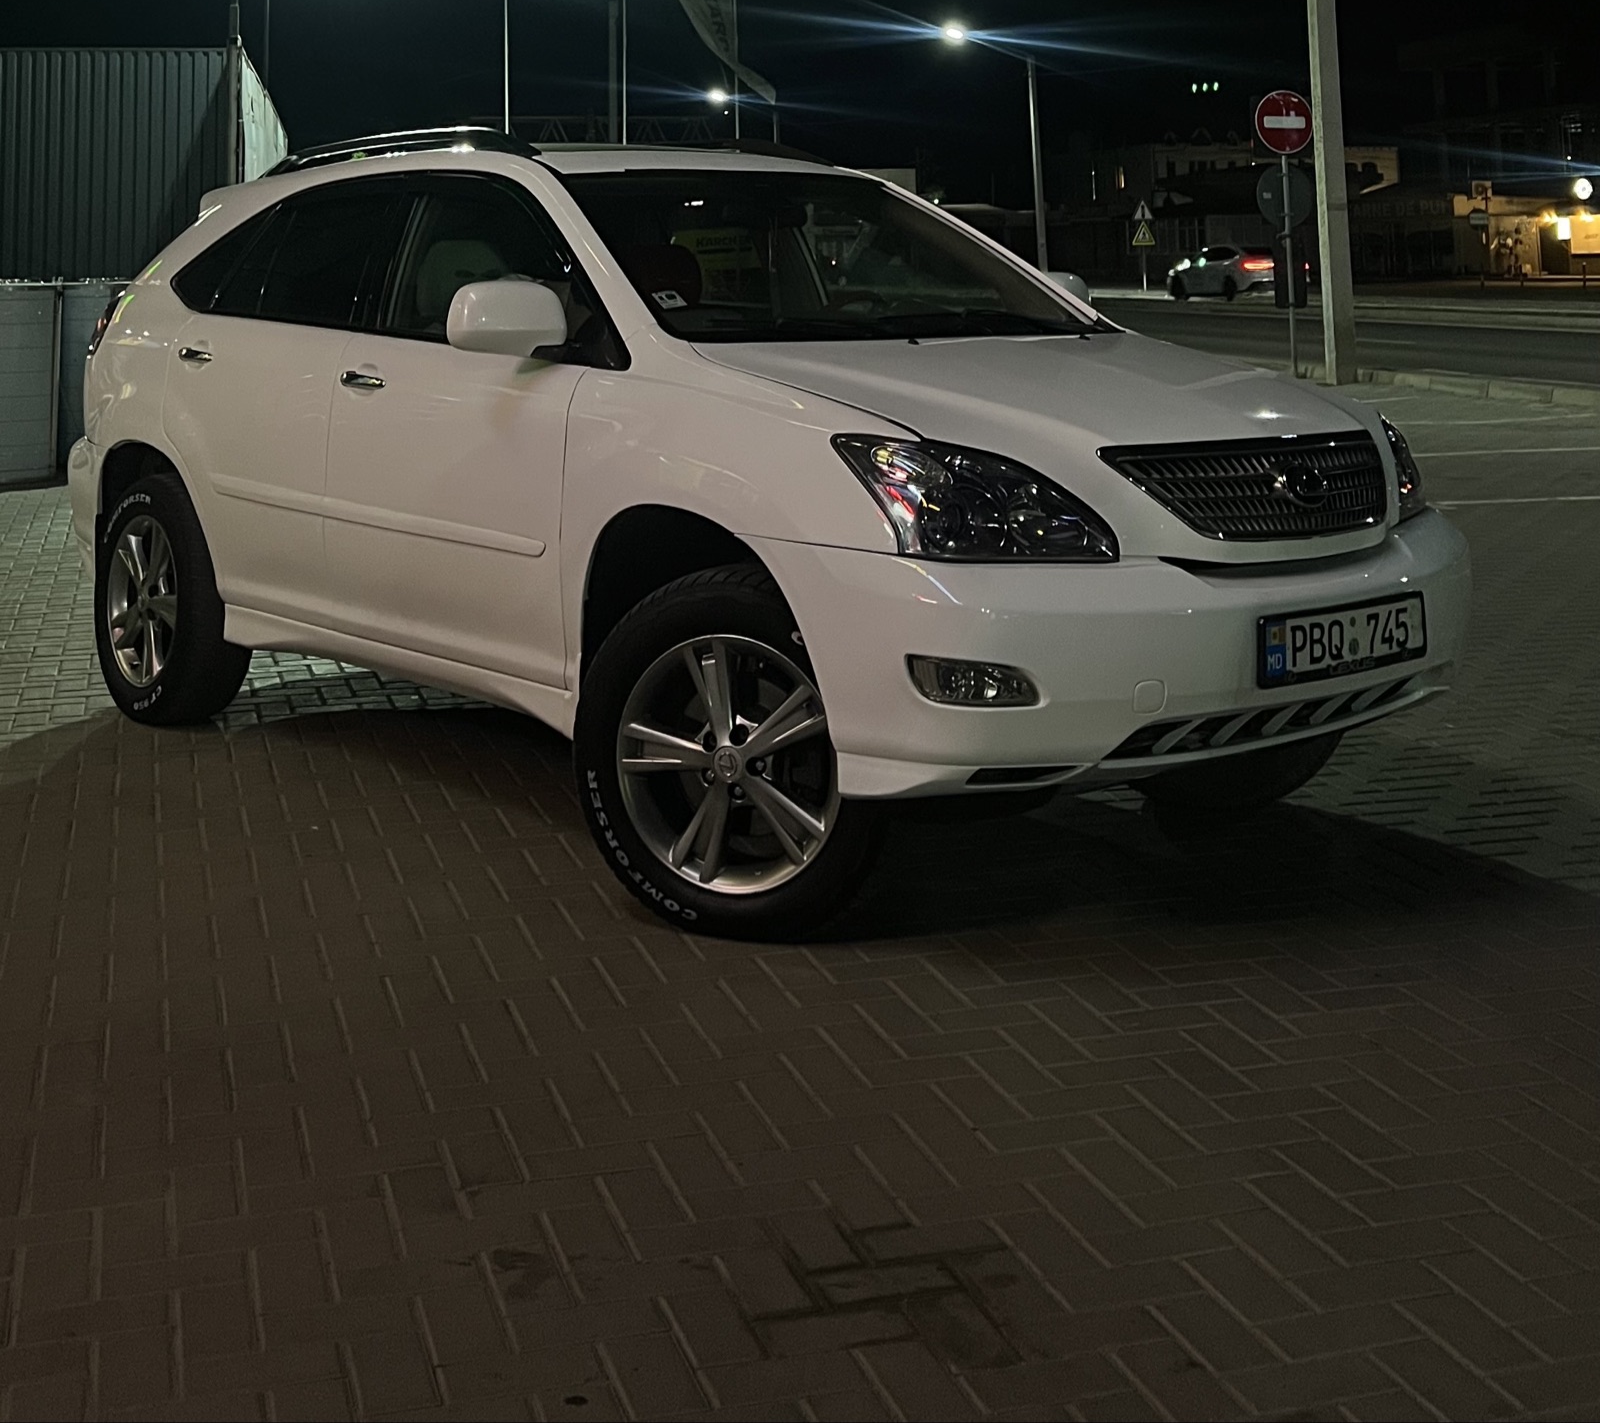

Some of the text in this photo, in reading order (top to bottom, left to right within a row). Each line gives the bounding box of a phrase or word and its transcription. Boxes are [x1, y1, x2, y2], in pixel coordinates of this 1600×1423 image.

[1350, 200, 1391, 218] ARNE
[1290, 608, 1409, 667] PBQ 745
[1267, 652, 1283, 671] MD
[1329, 657, 1376, 676] LEXUS
[586, 769, 699, 921] COMFORSER
